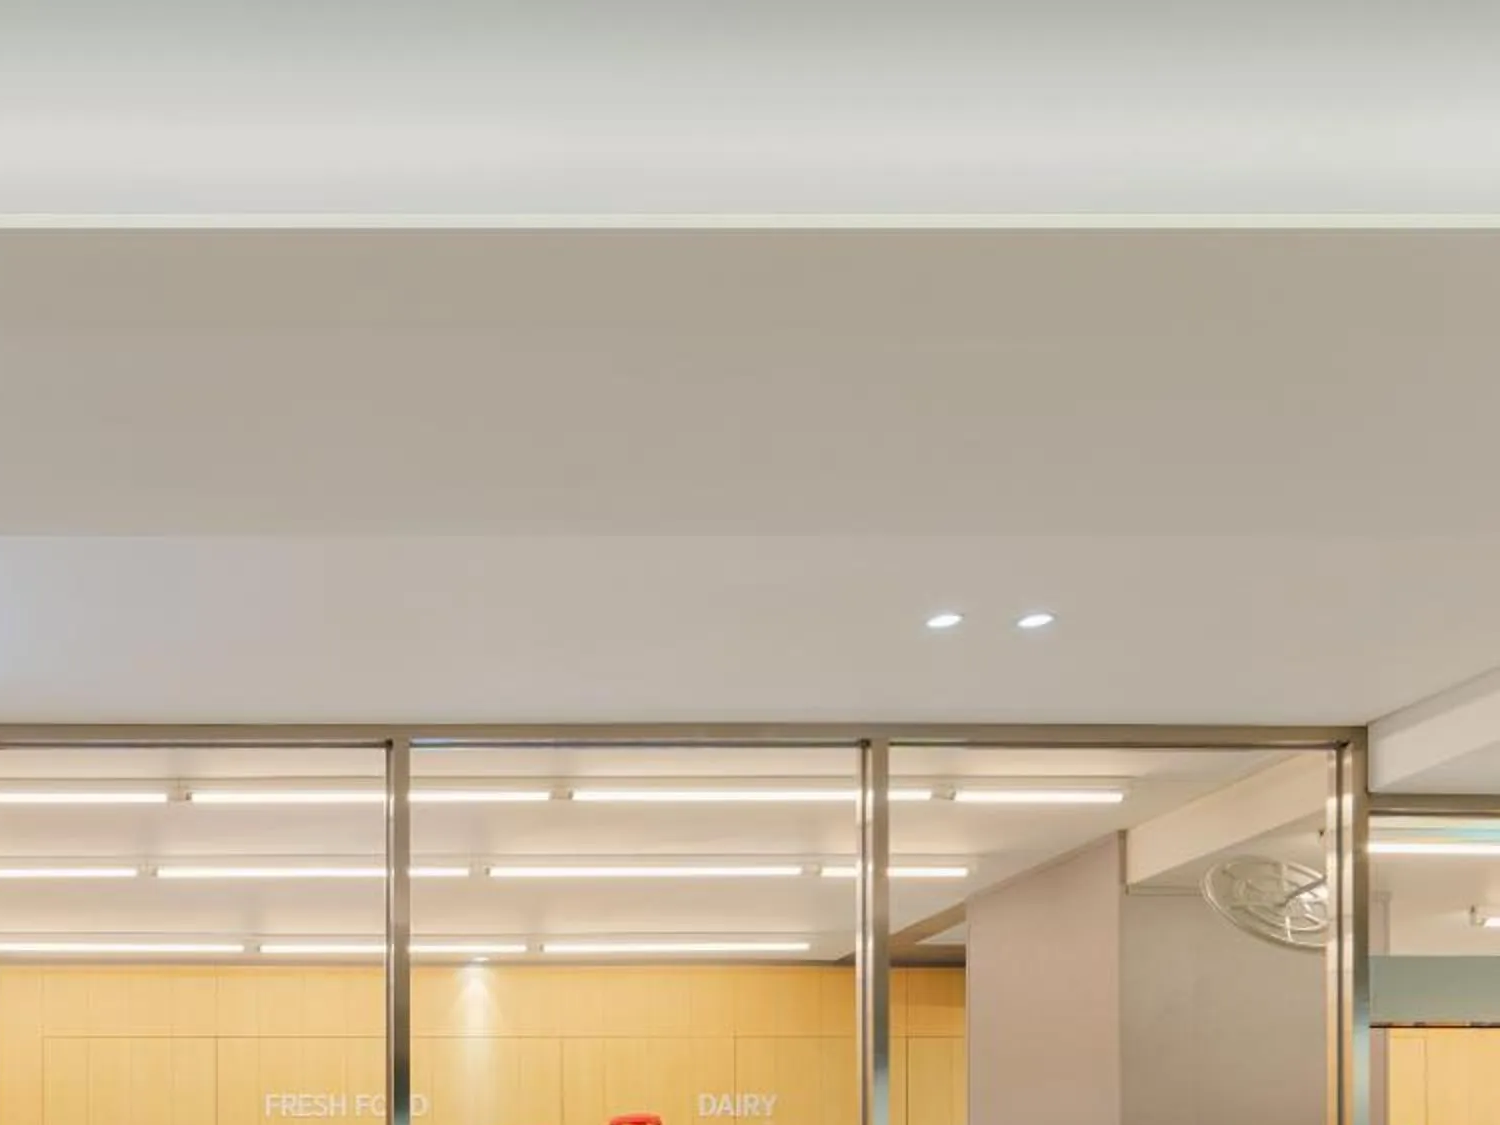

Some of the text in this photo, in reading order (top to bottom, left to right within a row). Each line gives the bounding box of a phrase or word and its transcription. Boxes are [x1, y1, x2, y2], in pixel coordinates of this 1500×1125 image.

[265, 1093, 429, 1117] FRESH FOD
[699, 1093, 777, 1117] DAIRY
